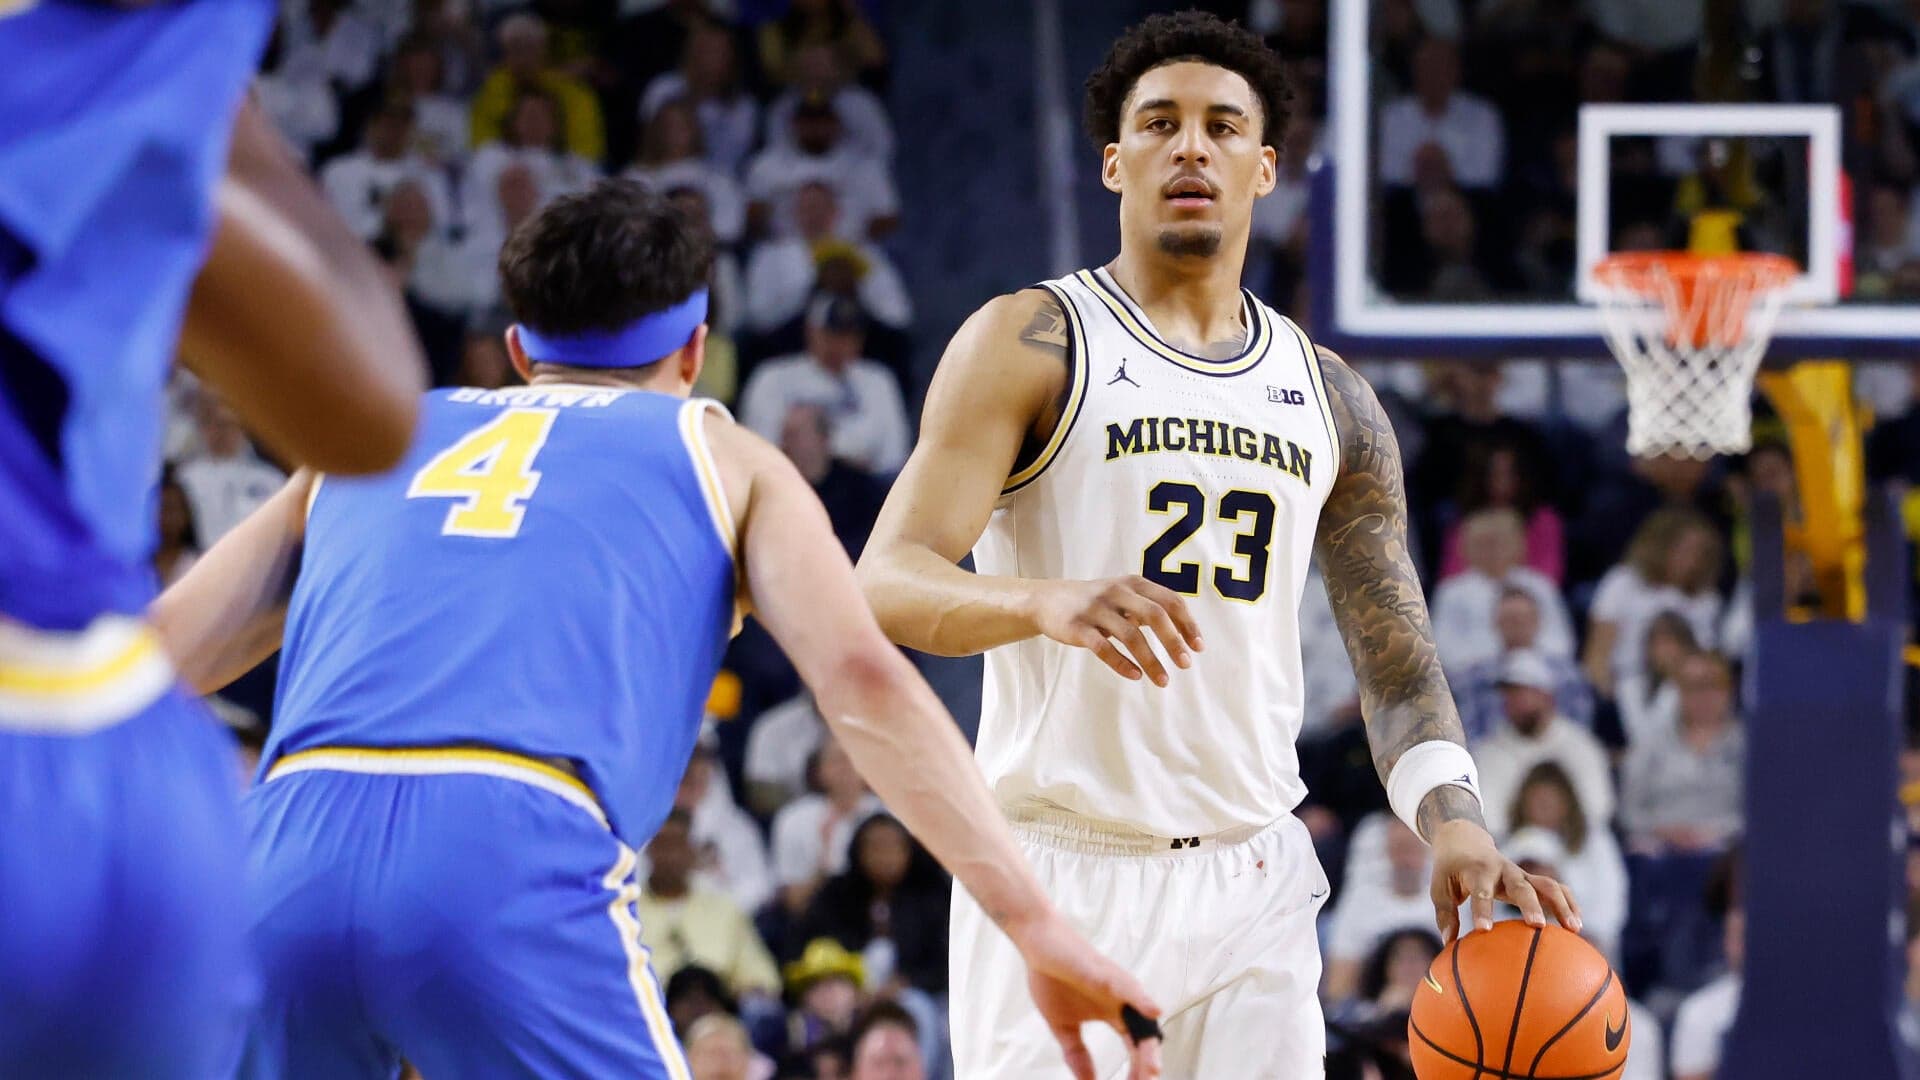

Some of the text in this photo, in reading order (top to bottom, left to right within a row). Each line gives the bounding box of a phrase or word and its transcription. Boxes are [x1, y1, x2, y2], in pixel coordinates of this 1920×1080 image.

[448, 387, 624, 407] BROWN
[406, 408, 560, 538] 4
[1105, 417, 1313, 487] MICHIGAN
[1143, 481, 1277, 603] 23
